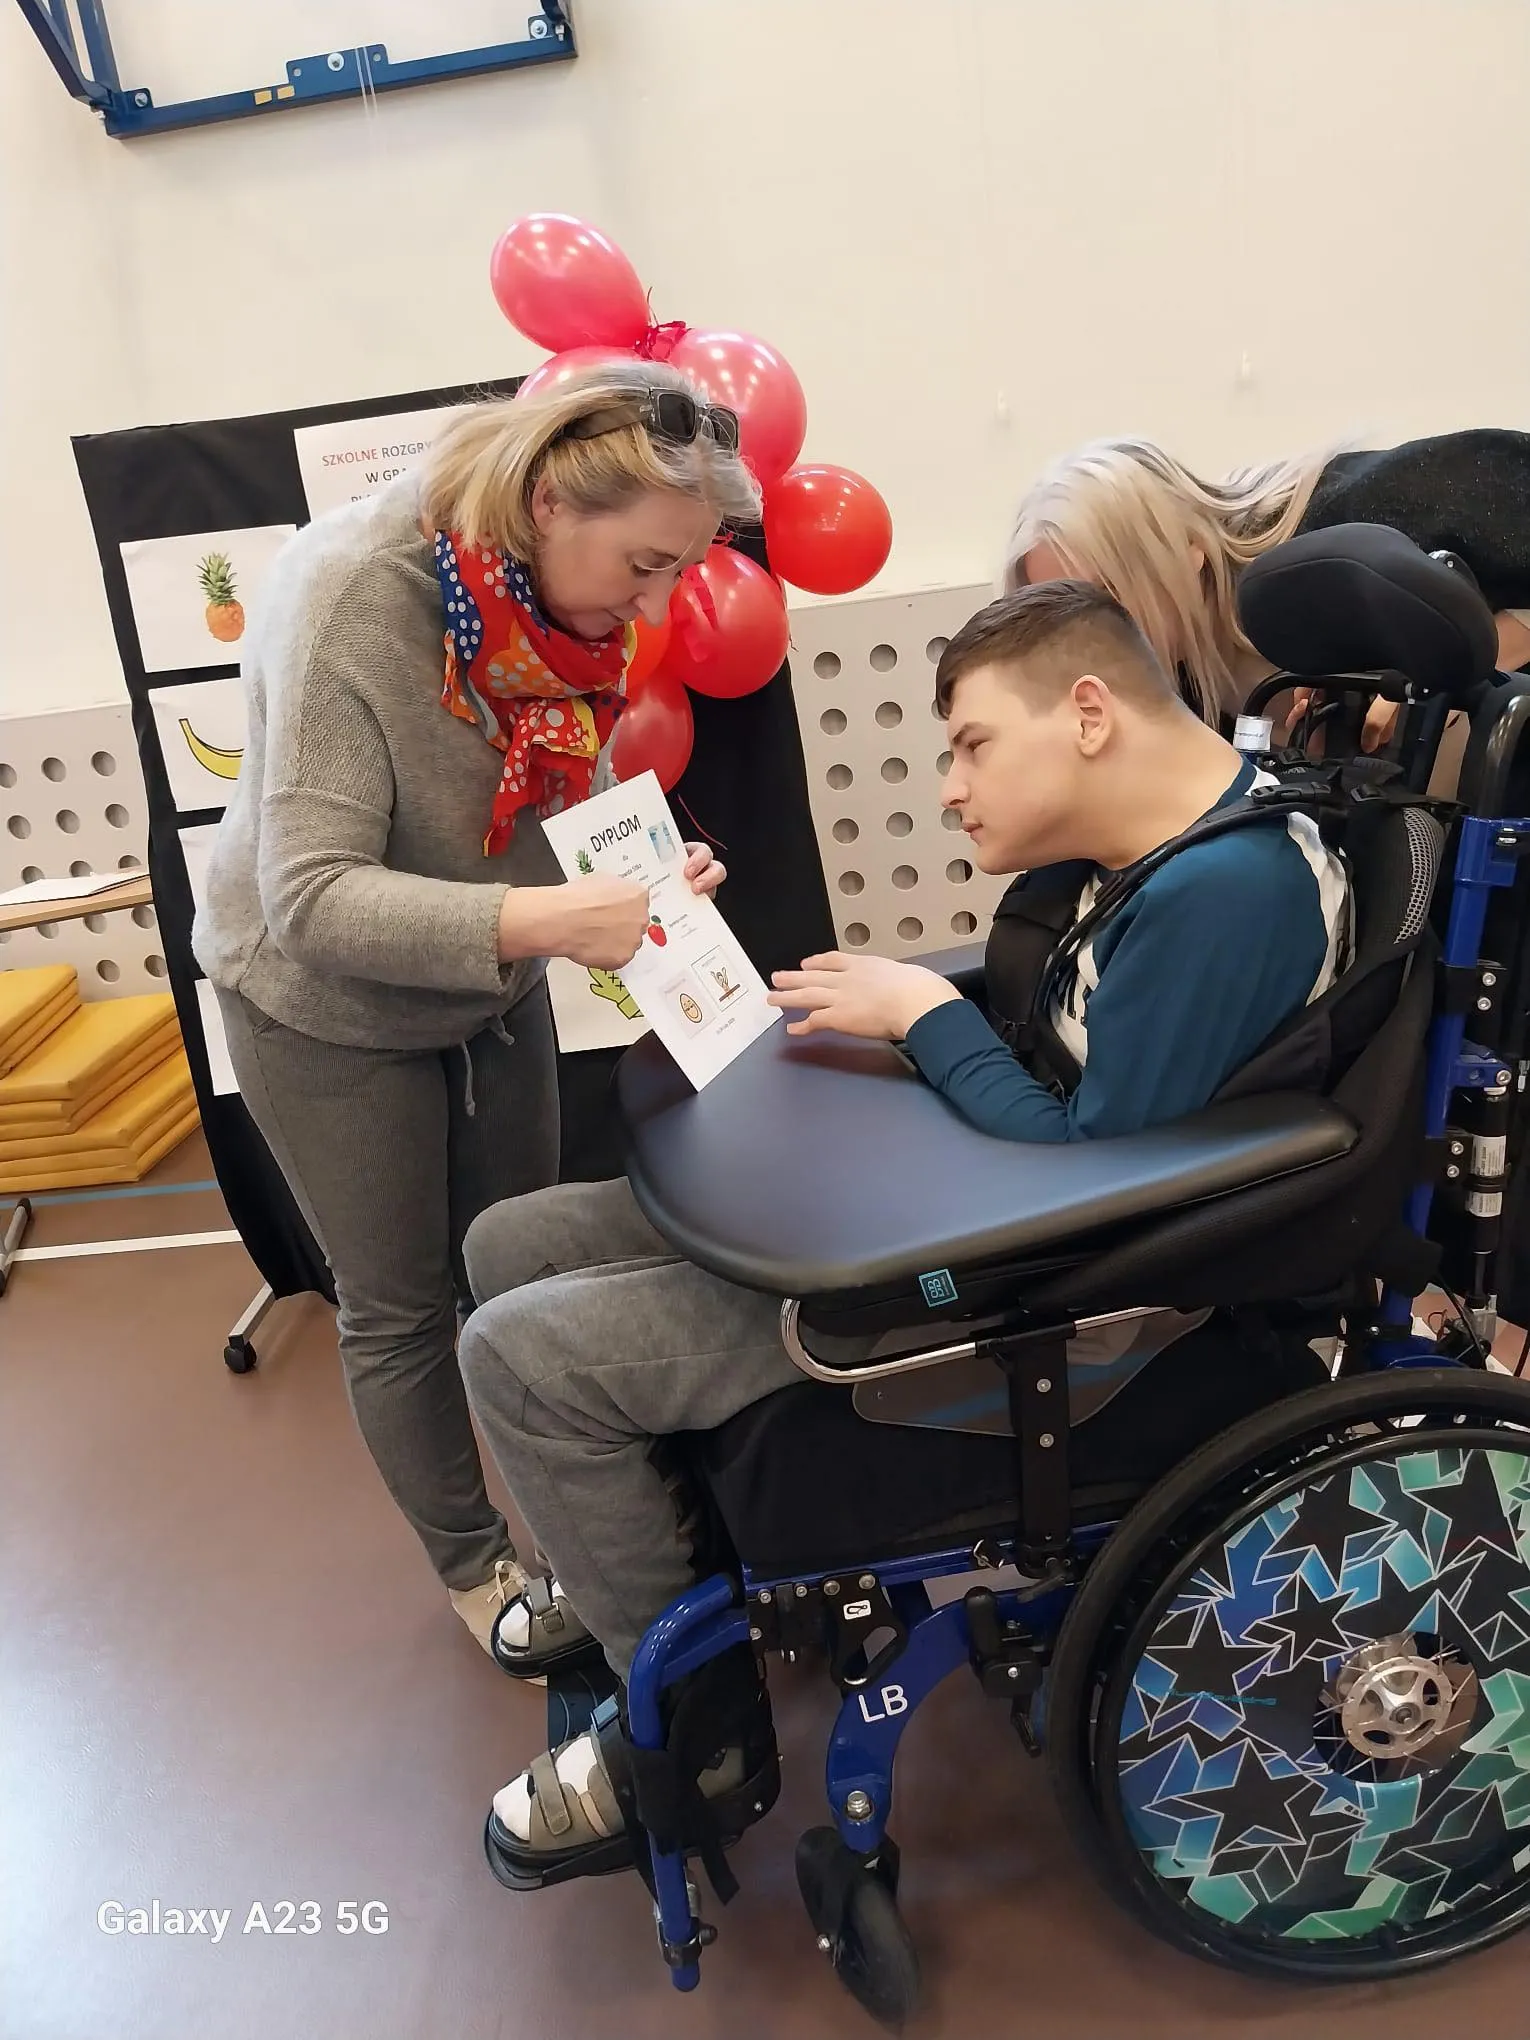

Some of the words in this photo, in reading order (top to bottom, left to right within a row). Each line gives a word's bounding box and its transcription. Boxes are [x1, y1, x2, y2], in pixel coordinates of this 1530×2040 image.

[322, 448, 378, 467] SZKOLNE
[365, 471, 379, 483] W
[590, 814, 642, 853] DYPLOM
[858, 1685, 908, 1722] LB
